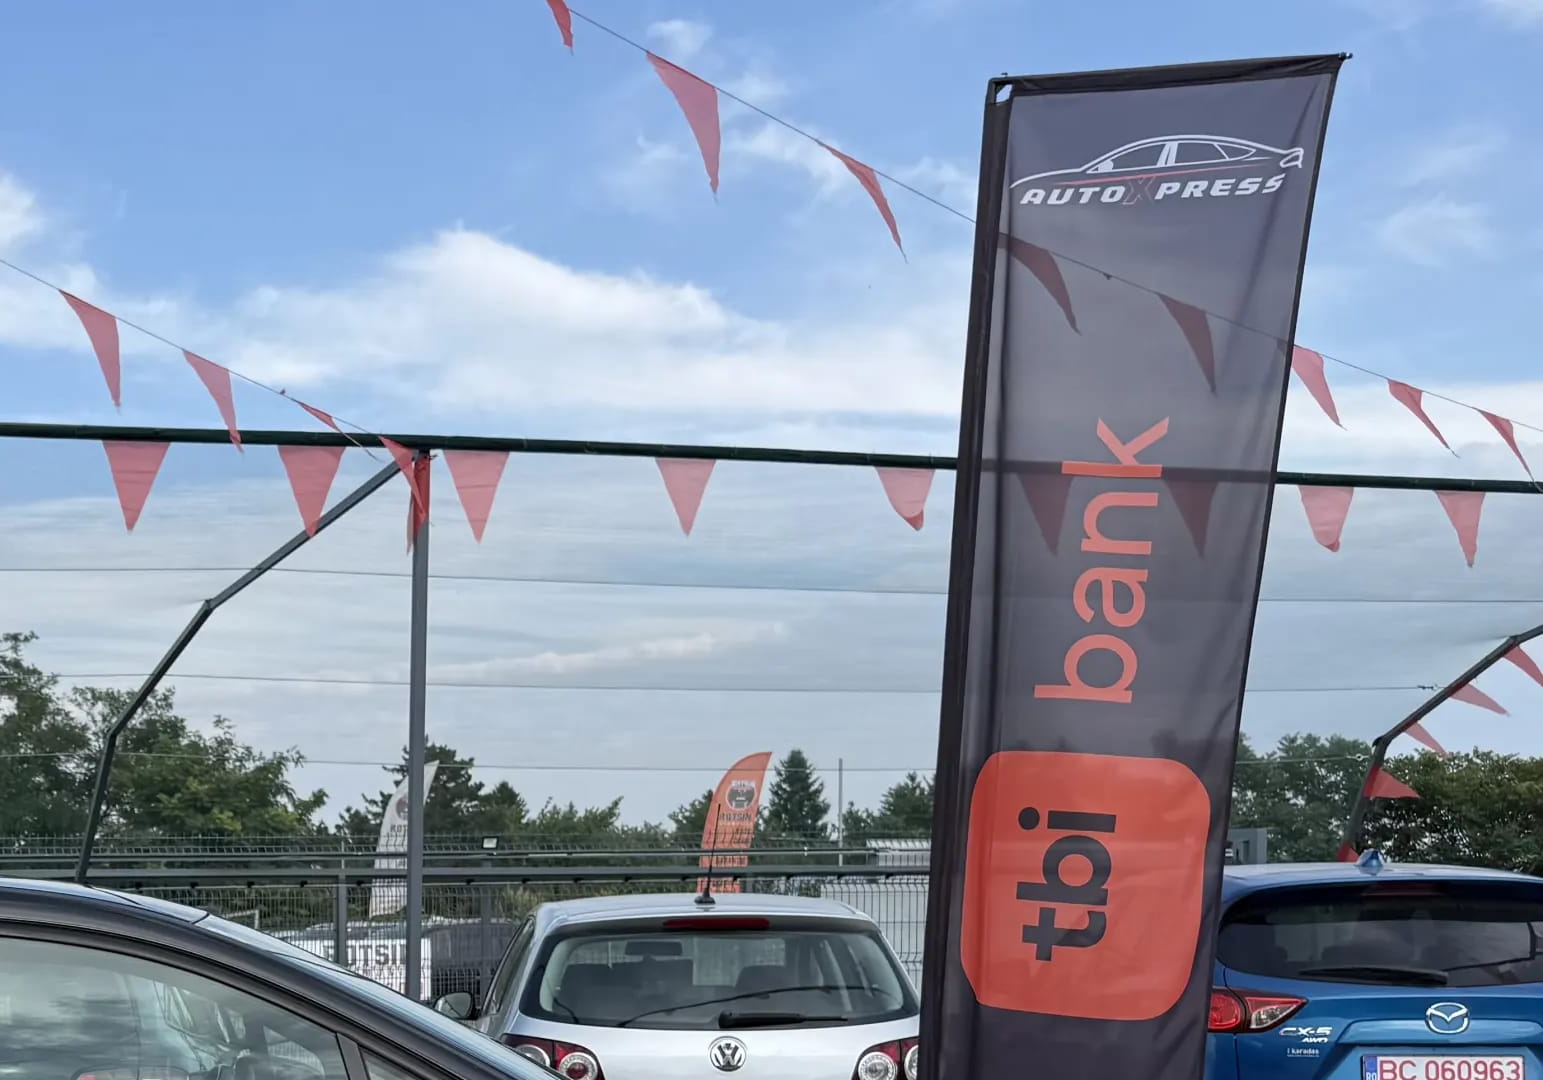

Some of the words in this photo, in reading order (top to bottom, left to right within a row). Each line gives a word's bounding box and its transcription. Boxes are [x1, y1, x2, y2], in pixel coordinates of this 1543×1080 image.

[1033, 416, 1170, 704] bank
[1015, 806, 1117, 962] tbi
[1278, 1026, 1333, 1036] CX-5
